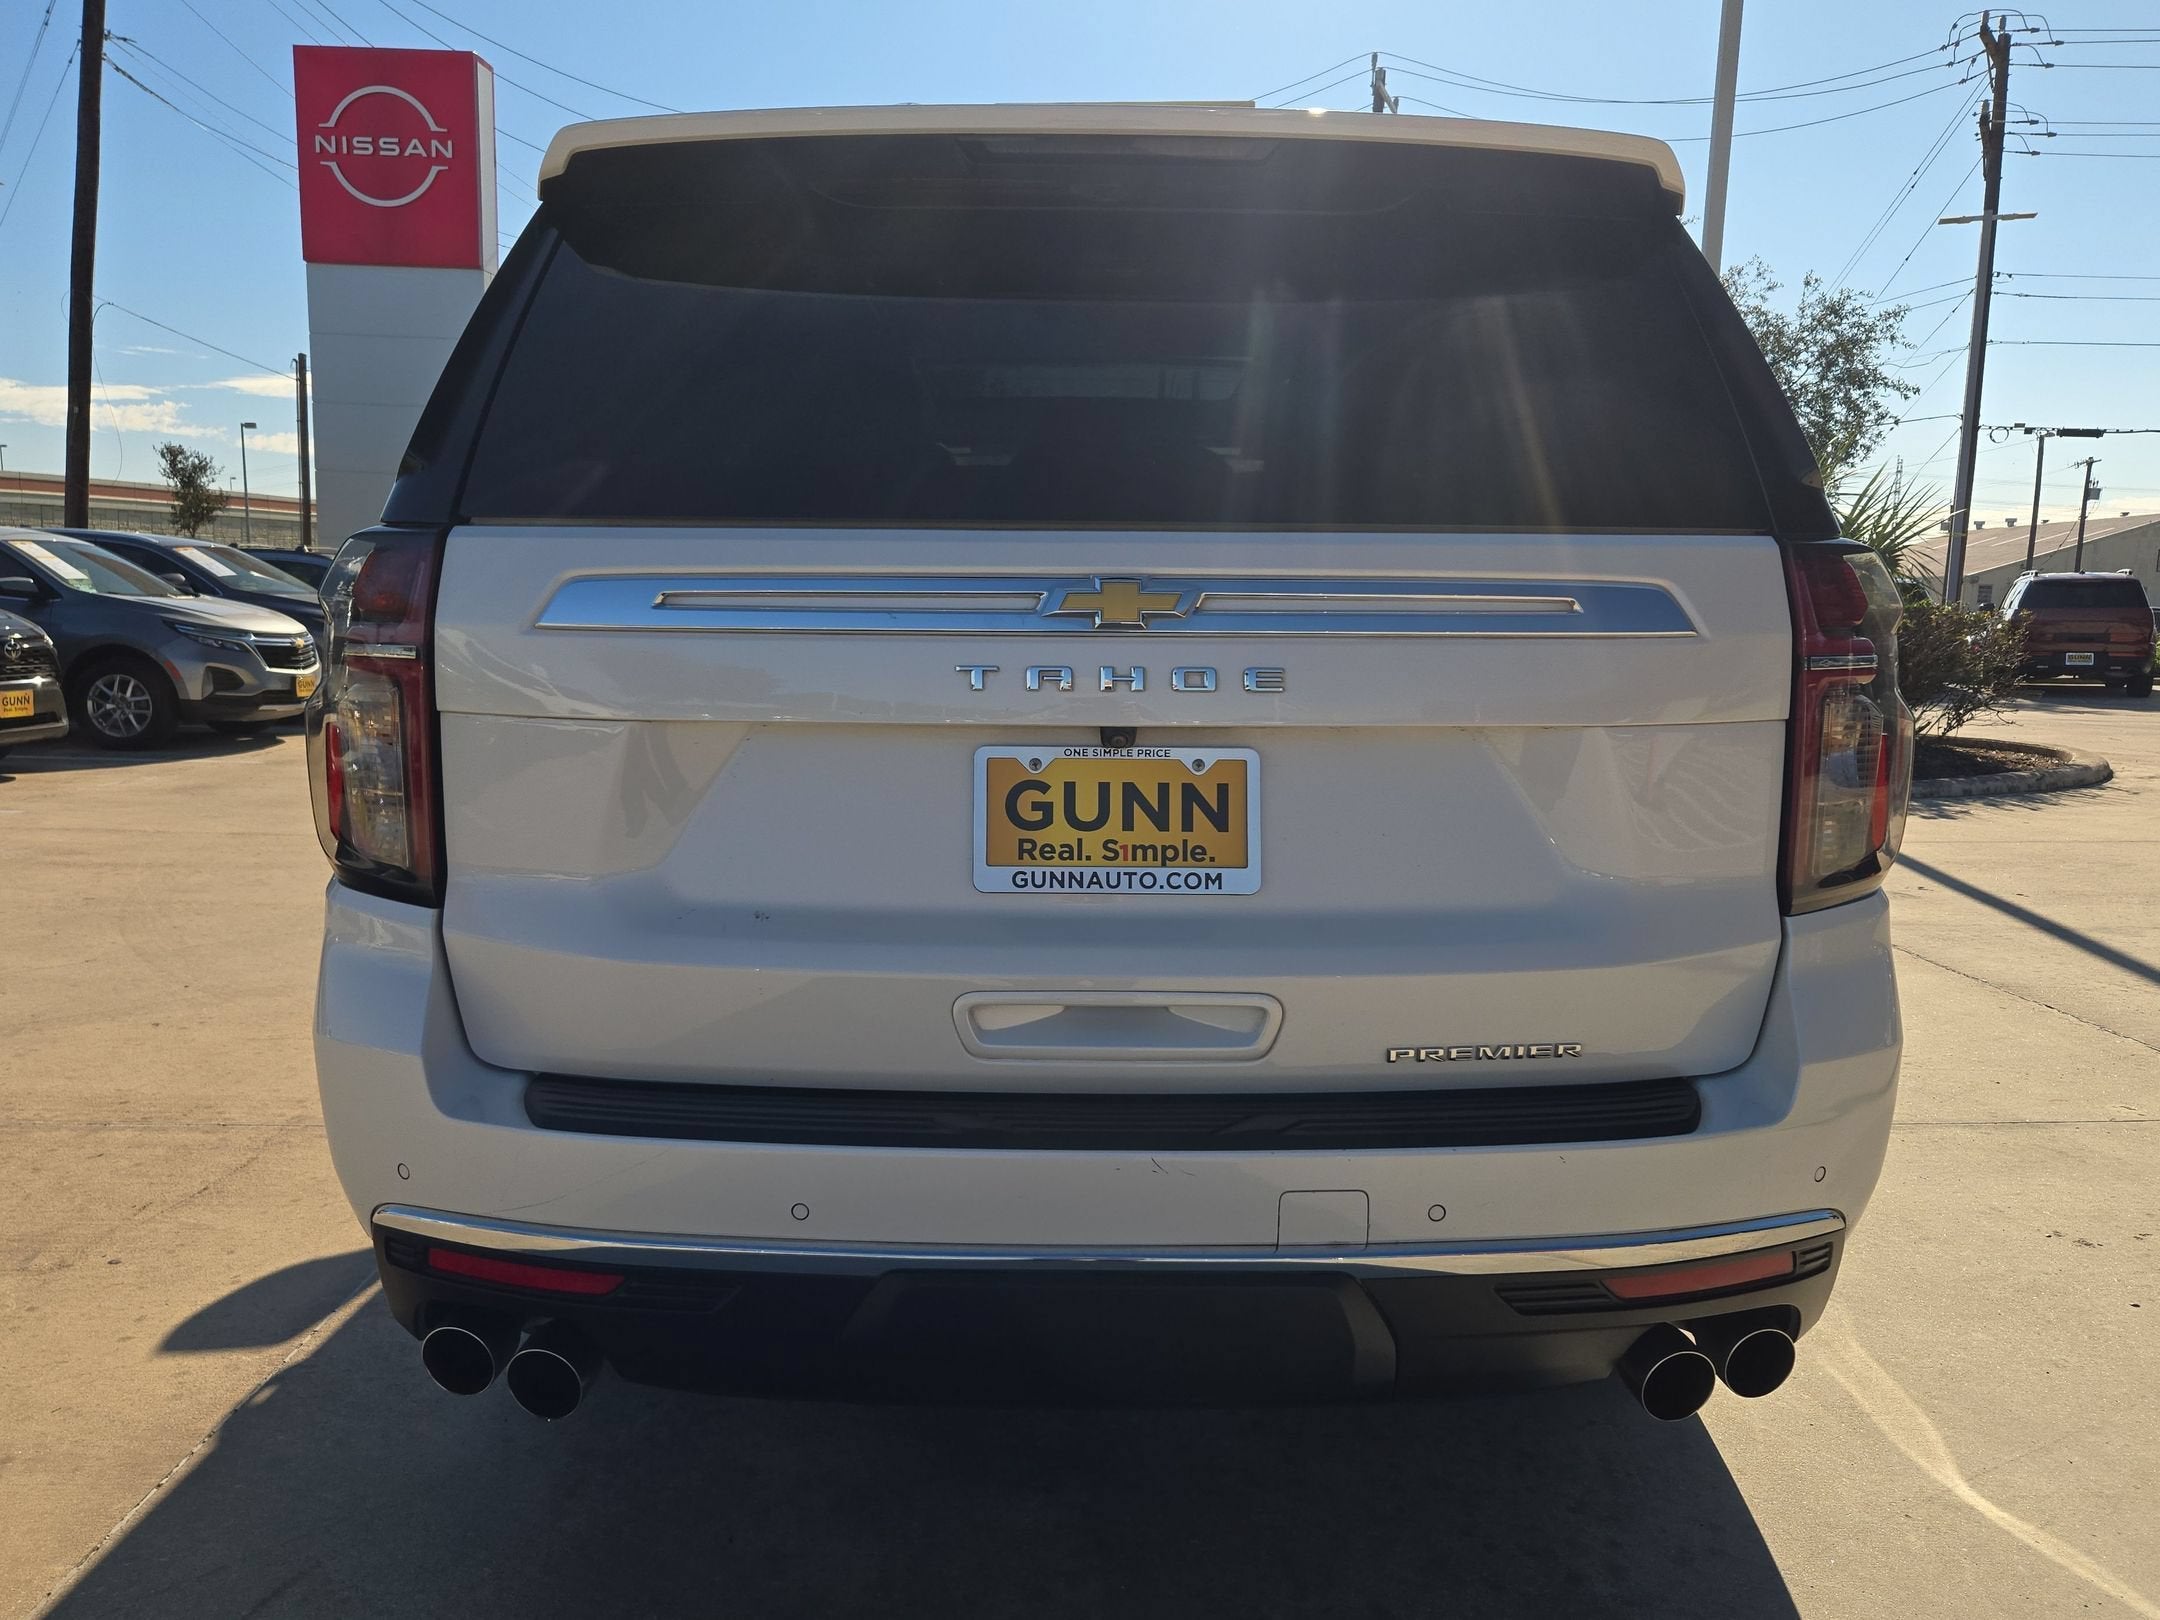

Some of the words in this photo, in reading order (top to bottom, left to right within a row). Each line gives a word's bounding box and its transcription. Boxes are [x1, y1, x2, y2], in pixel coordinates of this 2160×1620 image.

[315, 135, 453, 159] NISSAN
[954, 665, 1286, 692] TAHOE
[2, 695, 30, 706] GUNN
[1063, 748, 1089, 757] ONE
[1092, 748, 1134, 758] SIMPLE
[1137, 749, 1171, 758] PRICE
[1005, 780, 1229, 833] GUNN
[1017, 838, 1092, 861] Real.
[1012, 870, 1223, 890] GUNNAUTO.COM
[1387, 1042, 1583, 1063] PREMIER
